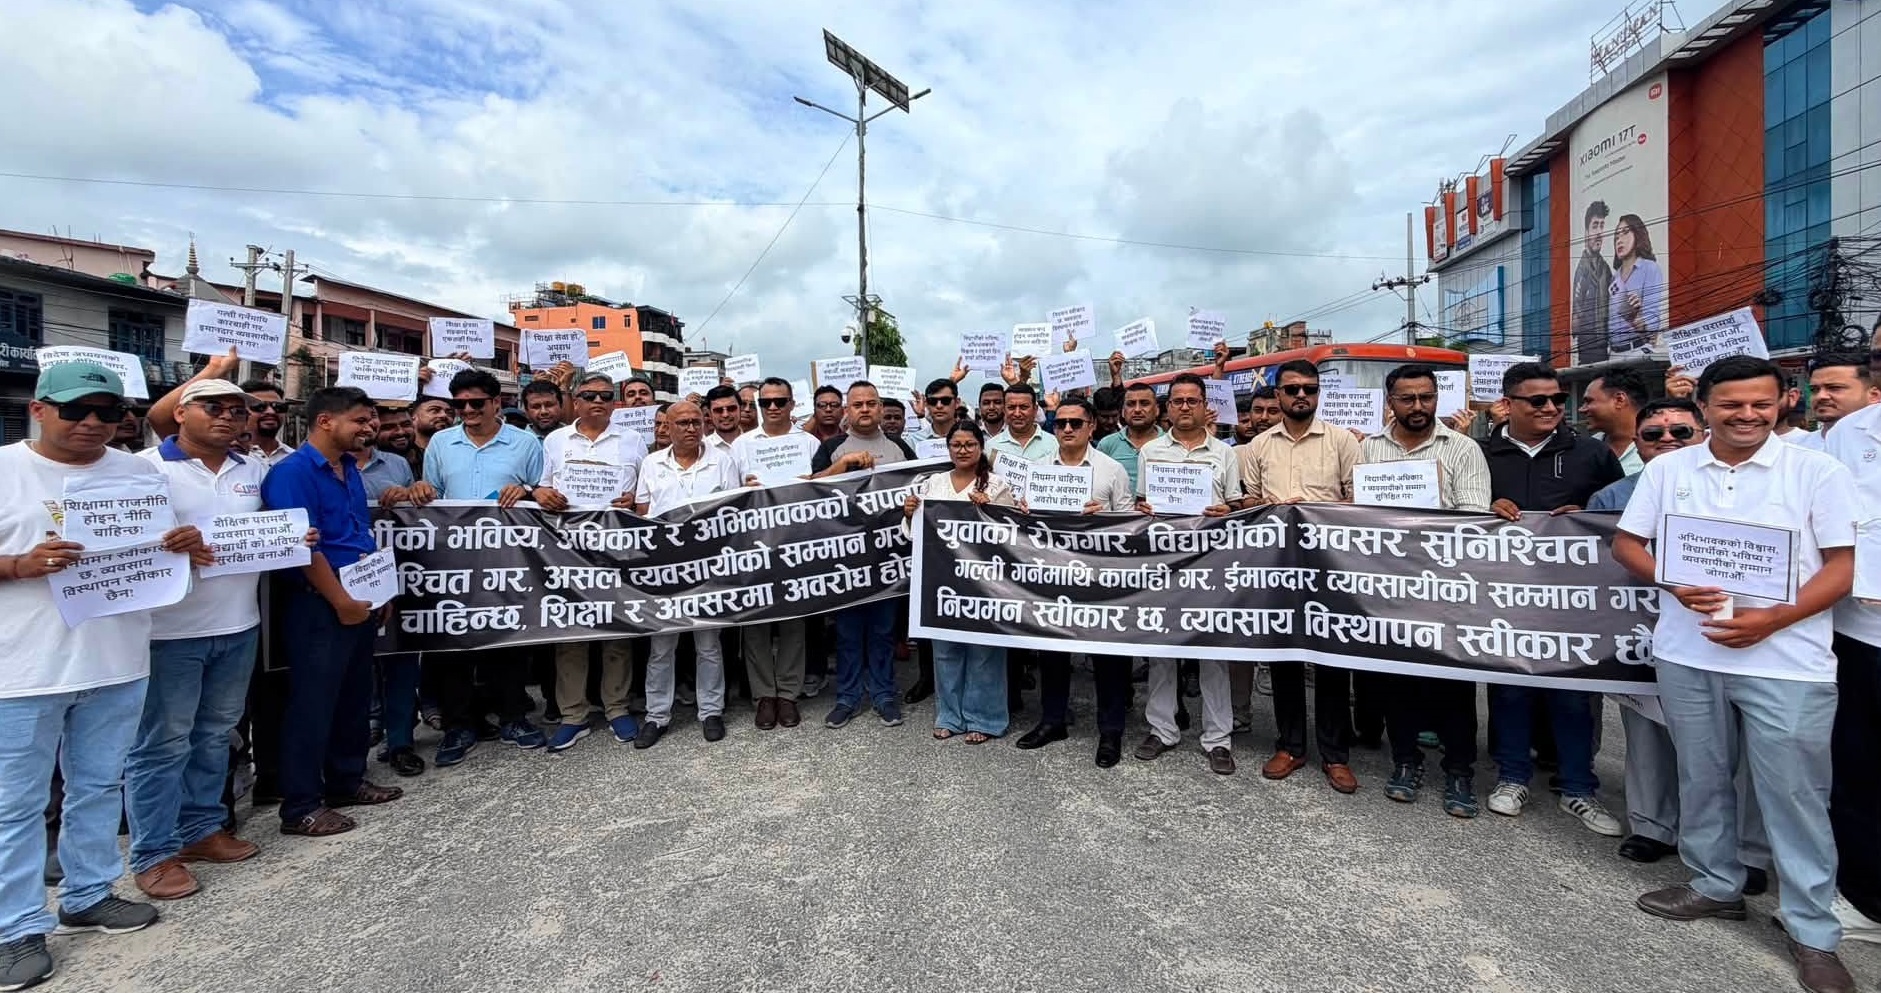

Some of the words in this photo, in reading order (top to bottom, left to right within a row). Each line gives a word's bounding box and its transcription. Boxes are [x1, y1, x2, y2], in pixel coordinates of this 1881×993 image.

[1618, 124, 1636, 143] 17T
[1005, 470, 1026, 483] अपरा
[1031, 471, 1056, 482] नियमन
[1029, 481, 1047, 493] शिक्षा
[1055, 485, 1088, 495] अवसरमा
[63, 499, 113, 512] शिक्षामा
[117, 495, 168, 509] राजनीति
[1033, 495, 1058, 504] अवरोध
[83, 512, 121, 526] होइन,
[124, 509, 152, 522] नीति
[252, 511, 288, 524] परामर्श
[447, 517, 545, 550] भविष्य,
[556, 521, 658, 551] अधिकार
[665, 524, 690, 547] र
[691, 488, 849, 542] अभिभावकको
[856, 483, 922, 515] सपन
[92, 525, 144, 538] चाहिन्छ!
[212, 528, 255, 540] व्यवसाय
[268, 535, 300, 546] भविष्य
[936, 516, 1020, 549] युवाको
[1028, 515, 1138, 554] रोजगार,
[1148, 515, 1288, 554] विद्यार्थीको
[1298, 523, 1410, 557] अवसर
[1420, 523, 1601, 568] सुनिश्चित
[1678, 532, 1741, 549] अभिभावकको
[1744, 540, 1779, 555] विश्वास,
[213, 552, 255, 566] सुरक्षित
[1682, 542, 1729, 558] विद्यार्थीको
[1731, 550, 1763, 562] भविष्य
[1766, 556, 1773, 564] र
[78, 569, 97, 580] छ,
[99, 558, 154, 573] व्यवसाय
[396, 561, 473, 597] श्चित
[483, 566, 533, 592] गर,
[543, 565, 622, 590] असल
[629, 540, 771, 588] व्यवसायीको
[779, 531, 866, 569] सम्मान
[1682, 554, 1736, 570] व्यवसायीको
[1739, 562, 1772, 575] सम्मान
[62, 575, 121, 599] विस्थापन
[124, 566, 174, 584] स्वीकार
[954, 554, 1005, 584] गल्ती
[1011, 558, 1096, 588] गर्नेमाथि
[1099, 561, 1172, 591] कार्वाही
[1178, 567, 1216, 592] गर,
[1224, 562, 1320, 593] ईमान्दार
[1326, 569, 1479, 604] व्यवसायीको
[1487, 582, 1598, 611] सम्मान
[104, 587, 134, 601] छैन!
[401, 599, 527, 635] चाहिन्छ,
[540, 595, 615, 628] शिक्षा
[624, 599, 646, 623] र
[655, 582, 774, 620] अवसरमा
[781, 563, 872, 602] अवरोध
[936, 586, 1023, 623] नियमन
[1032, 596, 1130, 633] स्वीकार
[1136, 605, 1170, 634] छ,
[1180, 606, 1295, 636] व्यवसाय
[1305, 600, 1445, 650] विस्थापन
[1456, 618, 1600, 665] स्वीकार
